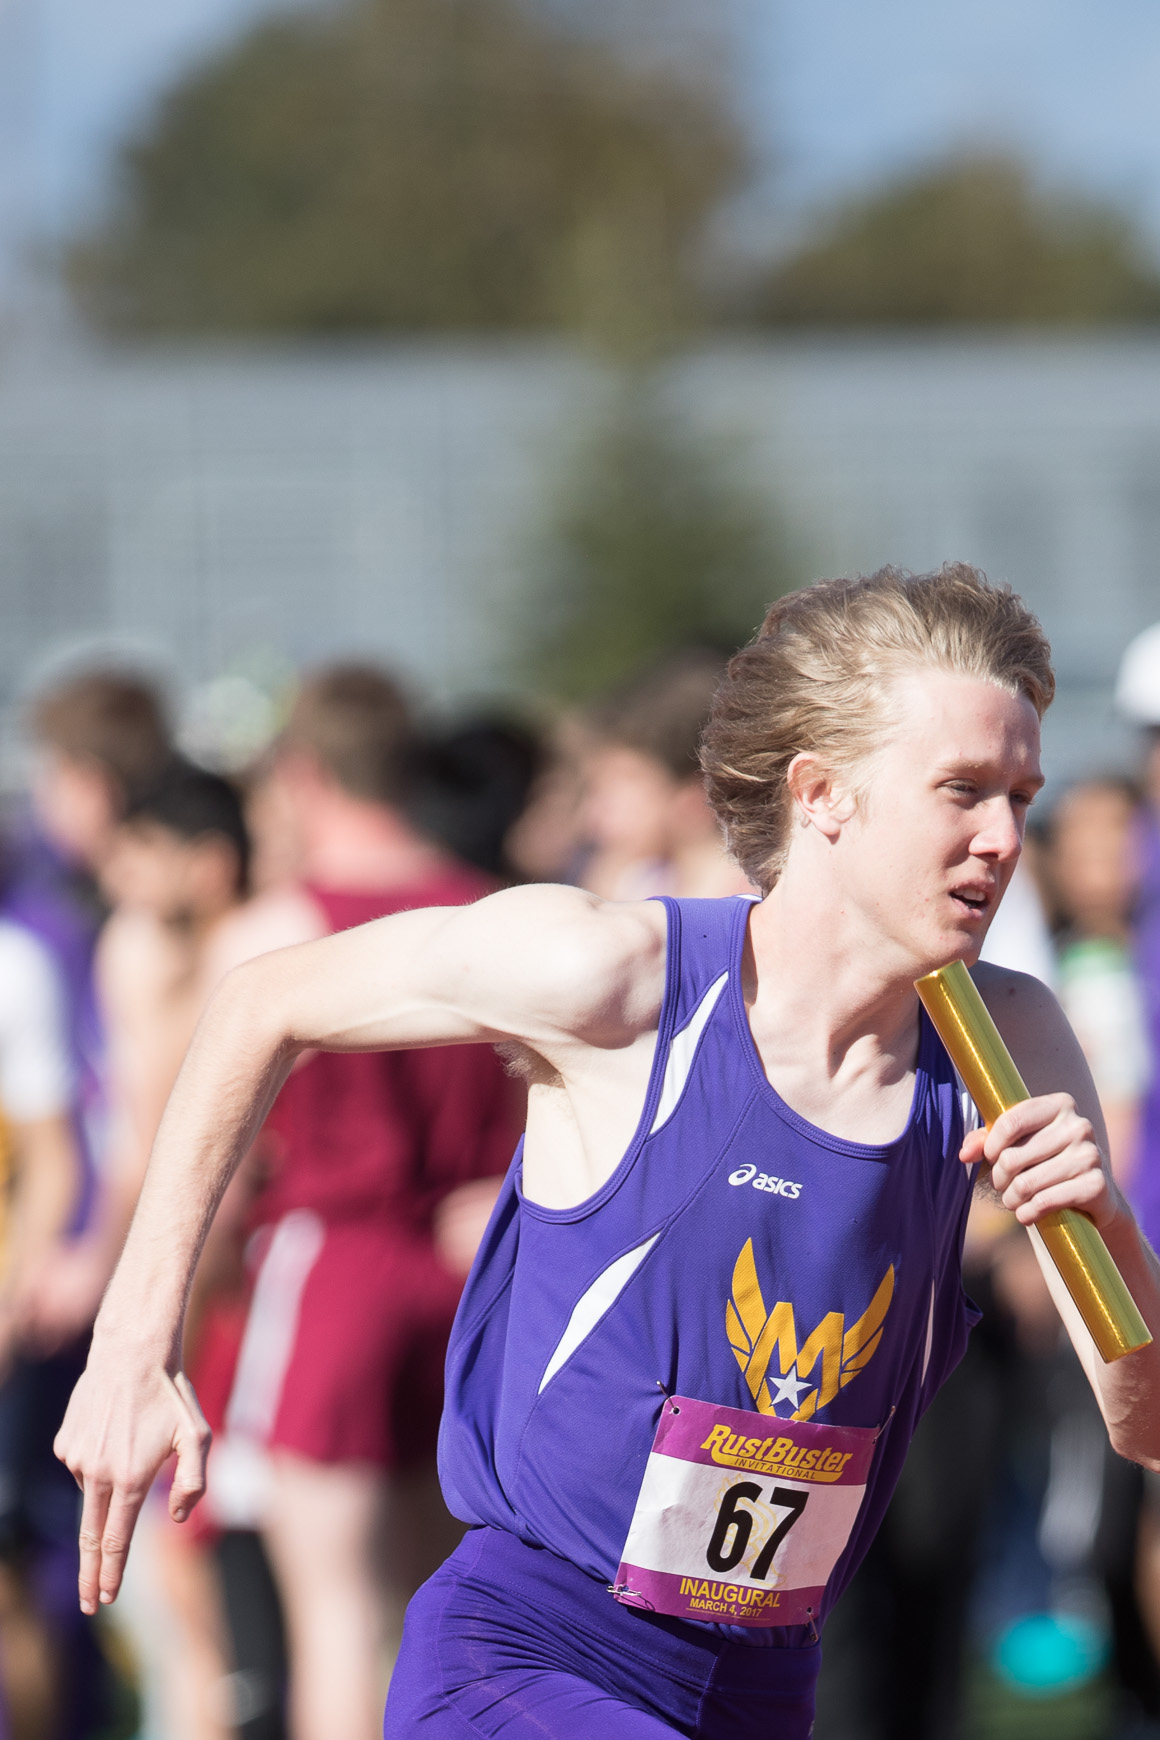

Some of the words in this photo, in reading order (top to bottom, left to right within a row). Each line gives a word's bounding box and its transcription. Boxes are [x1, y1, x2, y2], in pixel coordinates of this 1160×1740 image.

[752, 1172, 803, 1199] asics
[700, 1424, 853, 1472] RustBuster
[735, 1458, 816, 1480] INVITATIONAL
[706, 1481, 809, 1580] 67
[680, 1578, 781, 1608] INAUGURAL
[689, 1598, 727, 1613] MARCH
[728, 1605, 738, 1616] 4,
[739, 1606, 763, 1617] 2017
